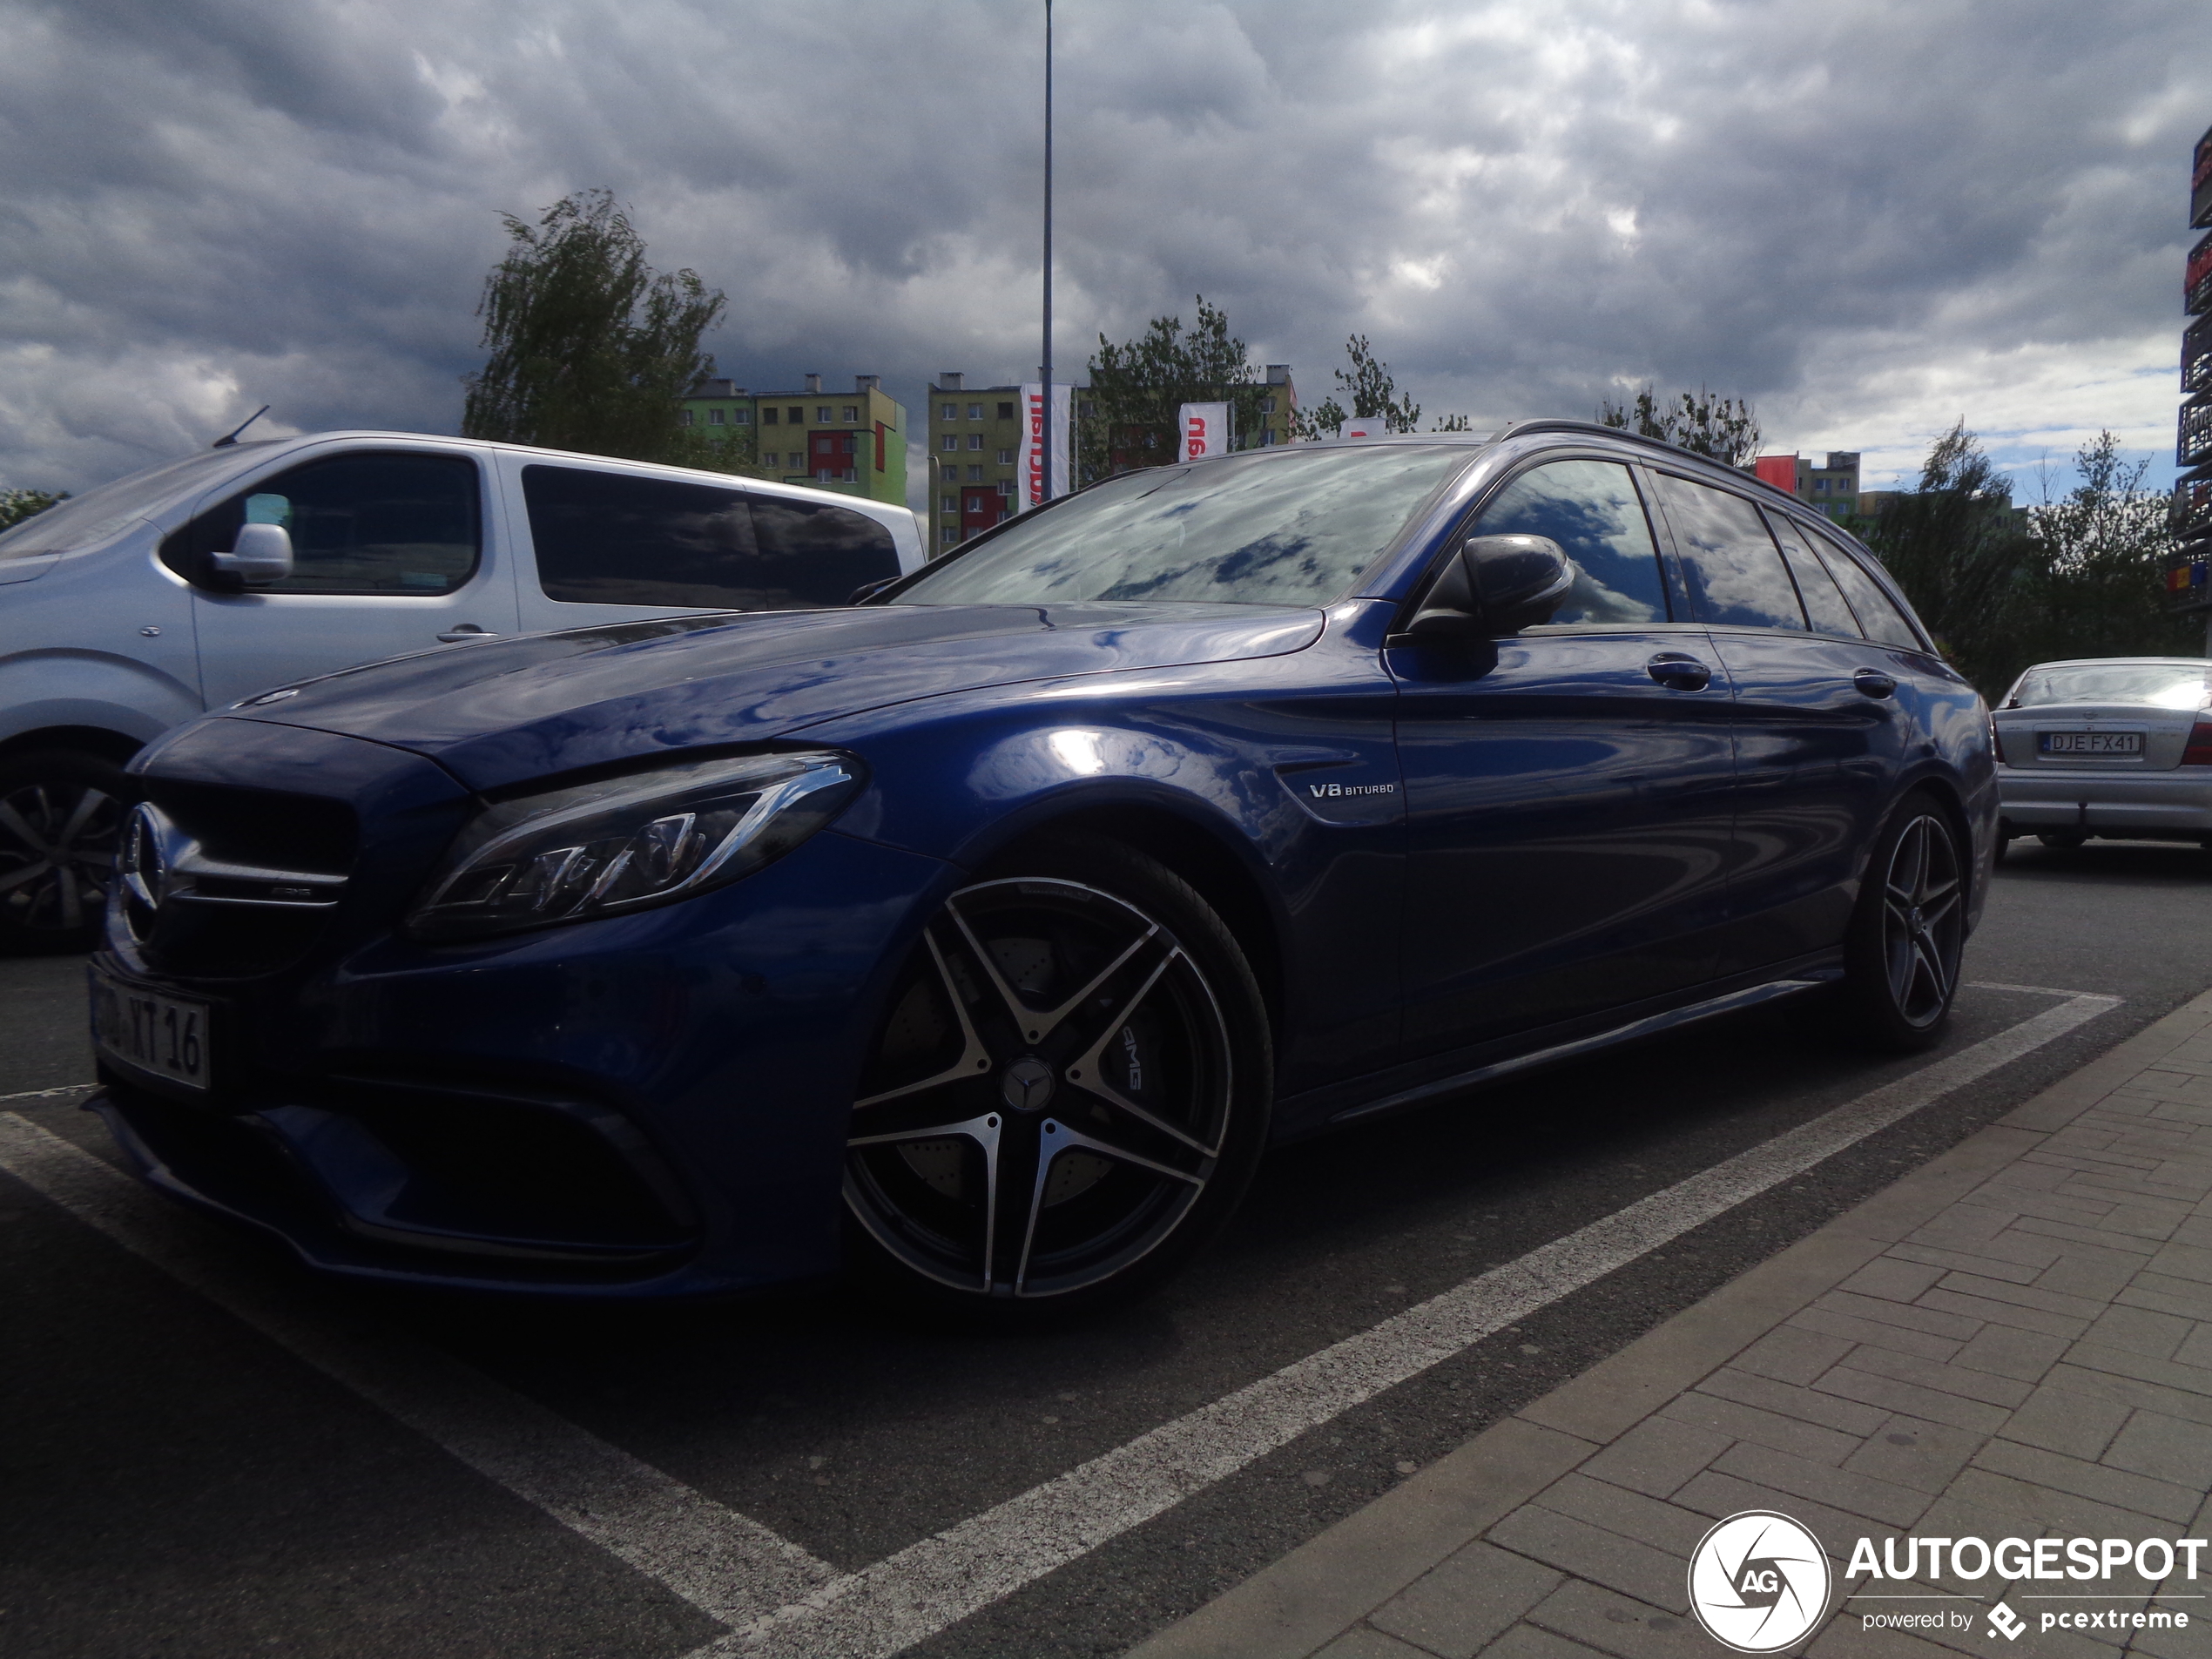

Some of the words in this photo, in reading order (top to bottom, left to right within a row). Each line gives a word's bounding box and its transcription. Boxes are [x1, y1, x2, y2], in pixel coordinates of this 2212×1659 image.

[1308, 783, 1342, 798] V8
[1345, 784, 1394, 796] BITURBO
[164, 1006, 200, 1076] 16
[1122, 1025, 1142, 1090] AMG
